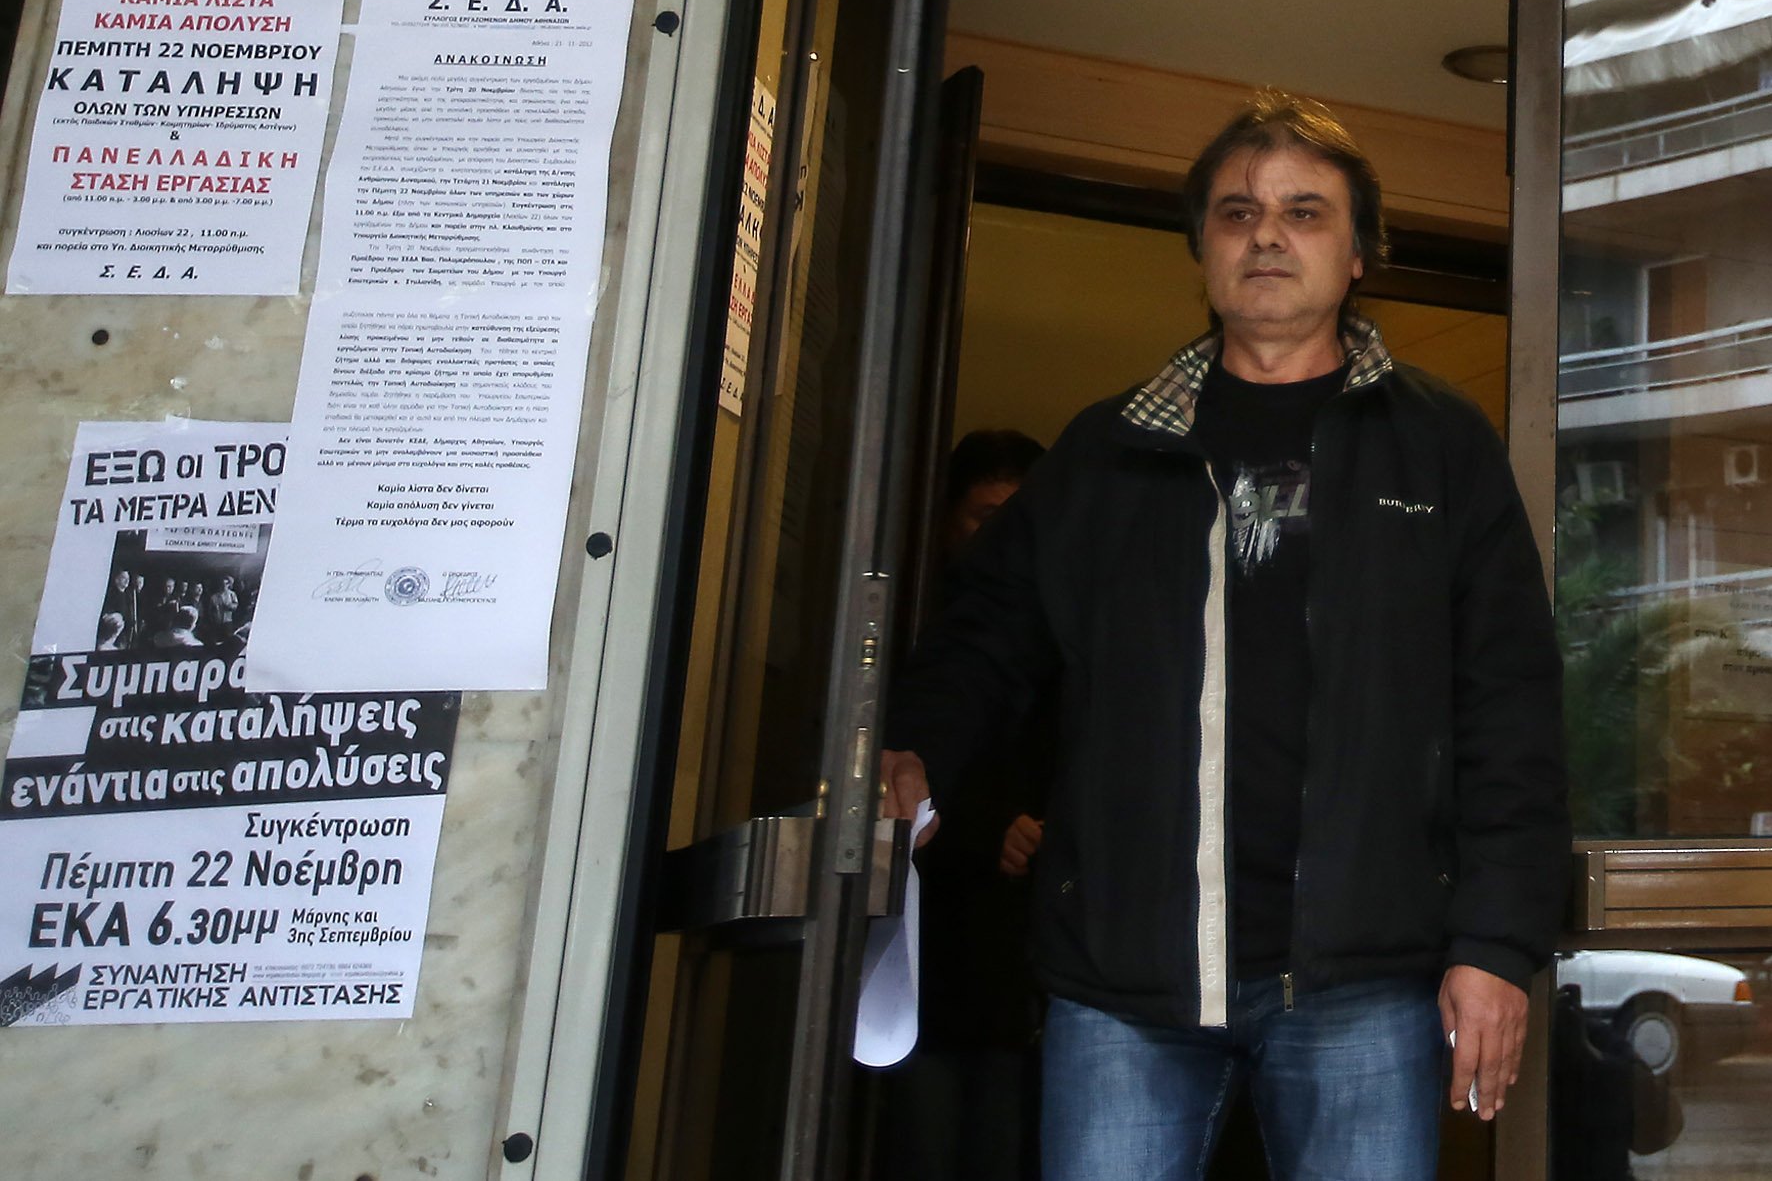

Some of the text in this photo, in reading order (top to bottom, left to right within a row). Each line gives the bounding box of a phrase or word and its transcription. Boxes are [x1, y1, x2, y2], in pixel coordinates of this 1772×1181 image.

[94, 13, 291, 32] ΚΑΜΙΑ ΑΠΟΛΥΣΗ
[57, 41, 322, 60] ΠΕΜΠΤΗ 22 ΝΟΕΜΒΡΙΟΥ
[434, 54, 548, 66] ΑΝΑΚΟΙΝΩΣΗ
[48, 68, 318, 96] ΚΑΤΑΛΗΨΗ
[73, 101, 281, 119] ΟΛΩΝ ΤΩΝ ΥΠΗΡΕΣΙΩΝ
[170, 130, 180, 140] &
[52, 146, 298, 169] ΠΑΝΕΛΛΑΔΙΚΗ
[71, 173, 272, 193] ΣΤΑΣΗ ΕΡΓΑΣΙΑΣ
[85, 442, 287, 486] ΕΞΩ οι ΤΡΟ
[377, 484, 489, 495] Καμία λίστα δεν δίνεται
[70, 487, 277, 525] ΤΑ ΜΕΤΡΑ ΔΕΝ
[367, 501, 494, 512] Καμία απόλυση δεν γίνεται
[335, 518, 514, 529] Τέρμα τα ευχολόγια δεν μας αφορούν
[100, 689, 421, 746] στις καταλήψεις
[11, 743, 446, 808] ενάντια στις απολύσεις
[244, 811, 411, 843] Συγκέντρωση
[40, 847, 402, 899] Πέμπτη 22 Νοέμβρη
[28, 901, 279, 949] ΕΚΑ 6.30μμ
[291, 906, 378, 927] Μάρνης και
[287, 927, 412, 947] 3ης Σεπτεμβρίου
[88, 962, 248, 986] ΣΥΝΑΝΤΗΣΗ
[82, 983, 404, 1010] ΕΡΓΑΤΙΚΗΣ ΑΝΤΙΣΤΑΣΗΣ
